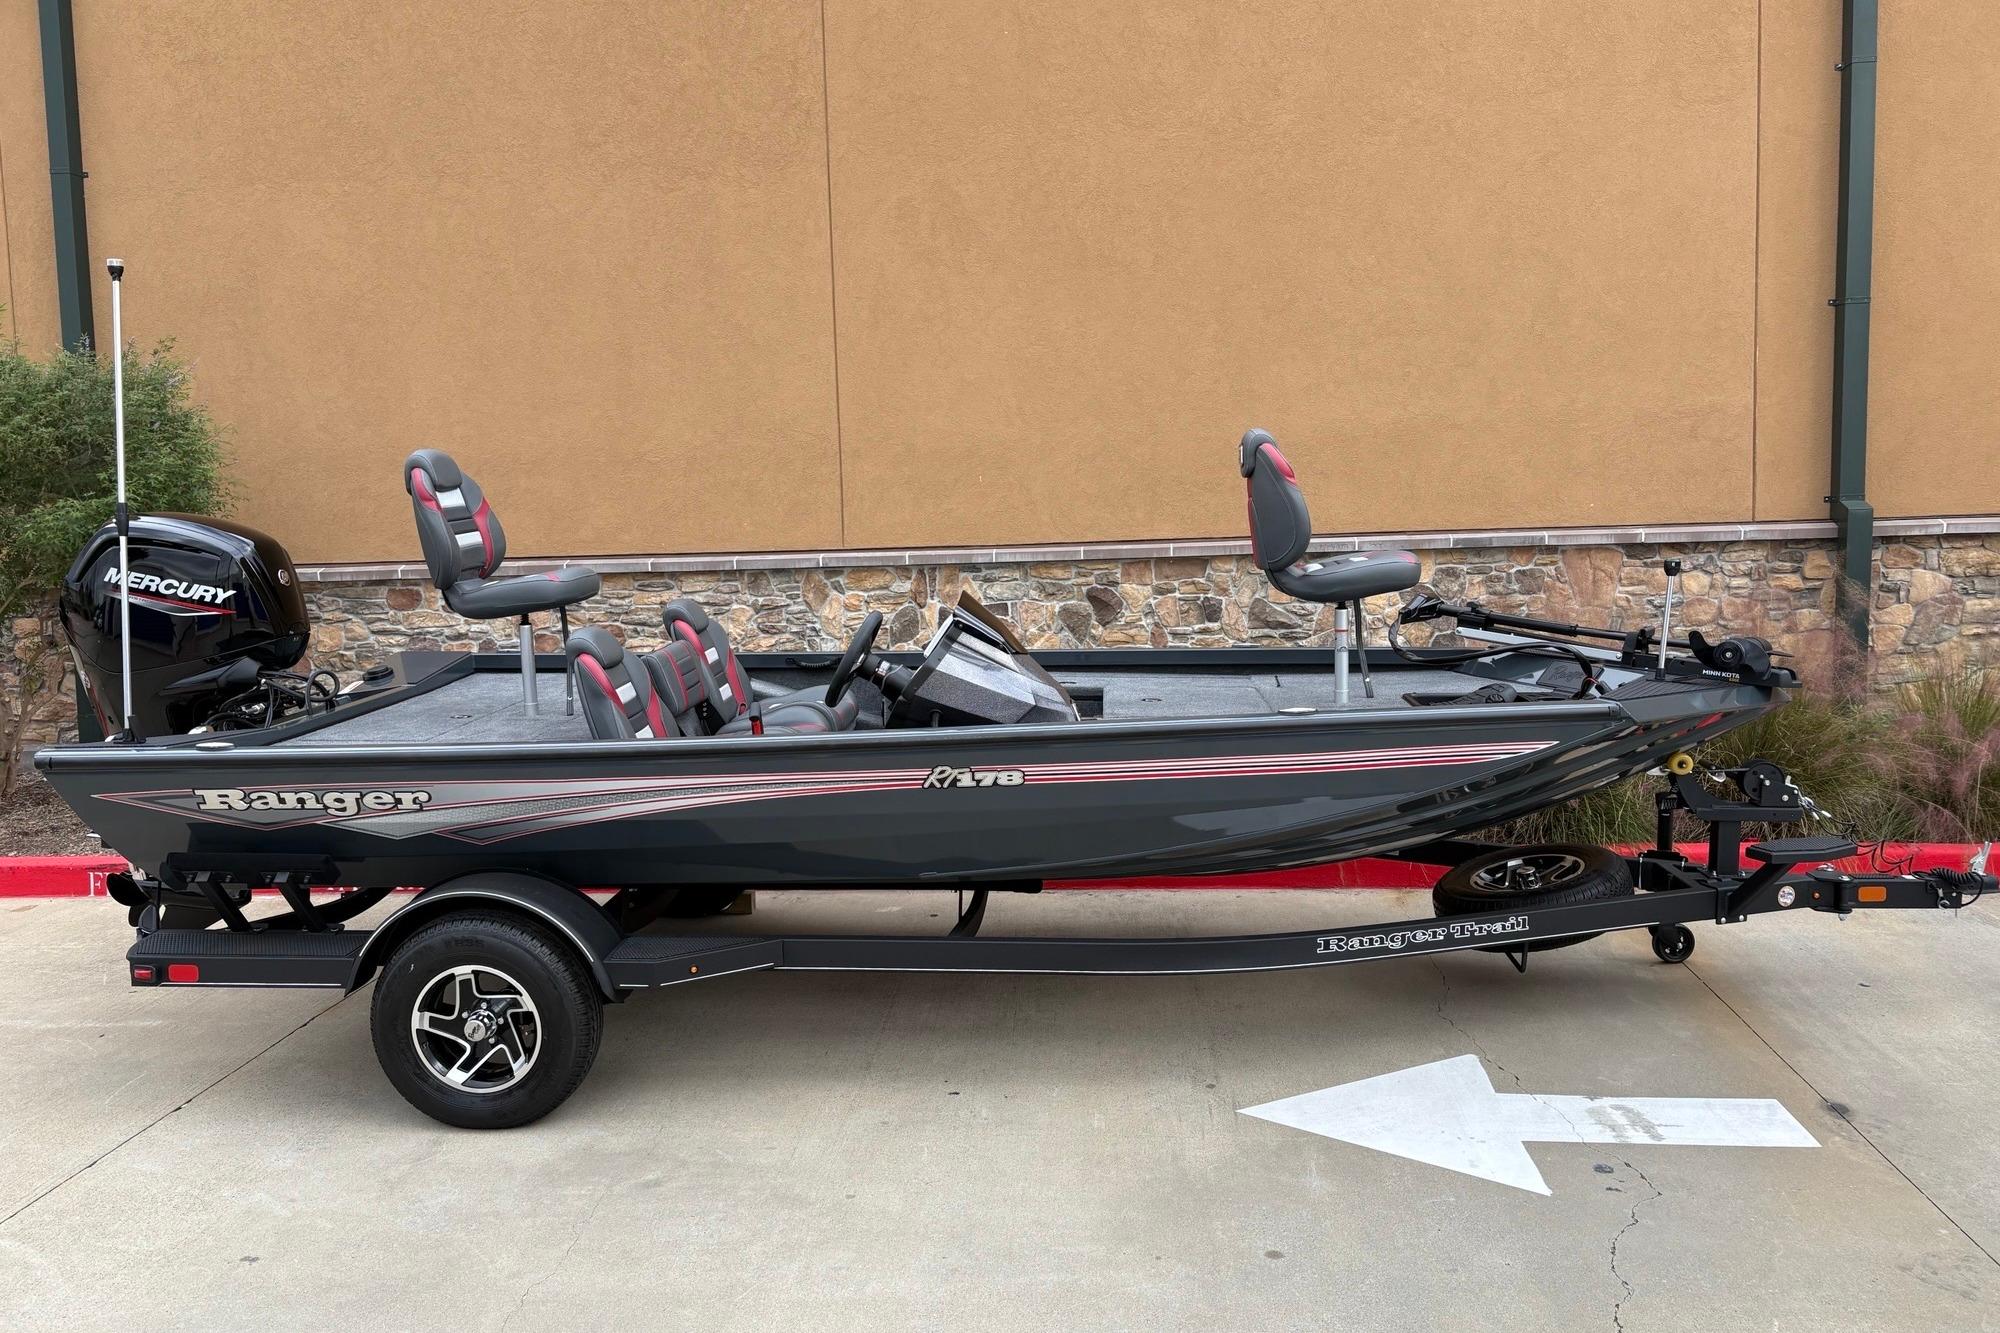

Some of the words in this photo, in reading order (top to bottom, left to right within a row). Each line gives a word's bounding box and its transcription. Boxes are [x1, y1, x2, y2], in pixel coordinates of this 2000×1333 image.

[103, 567, 237, 604] MERCURY
[193, 788, 432, 816] Ranger
[1316, 927, 1448, 954] Ranger
[1450, 916, 1529, 939] Trail
